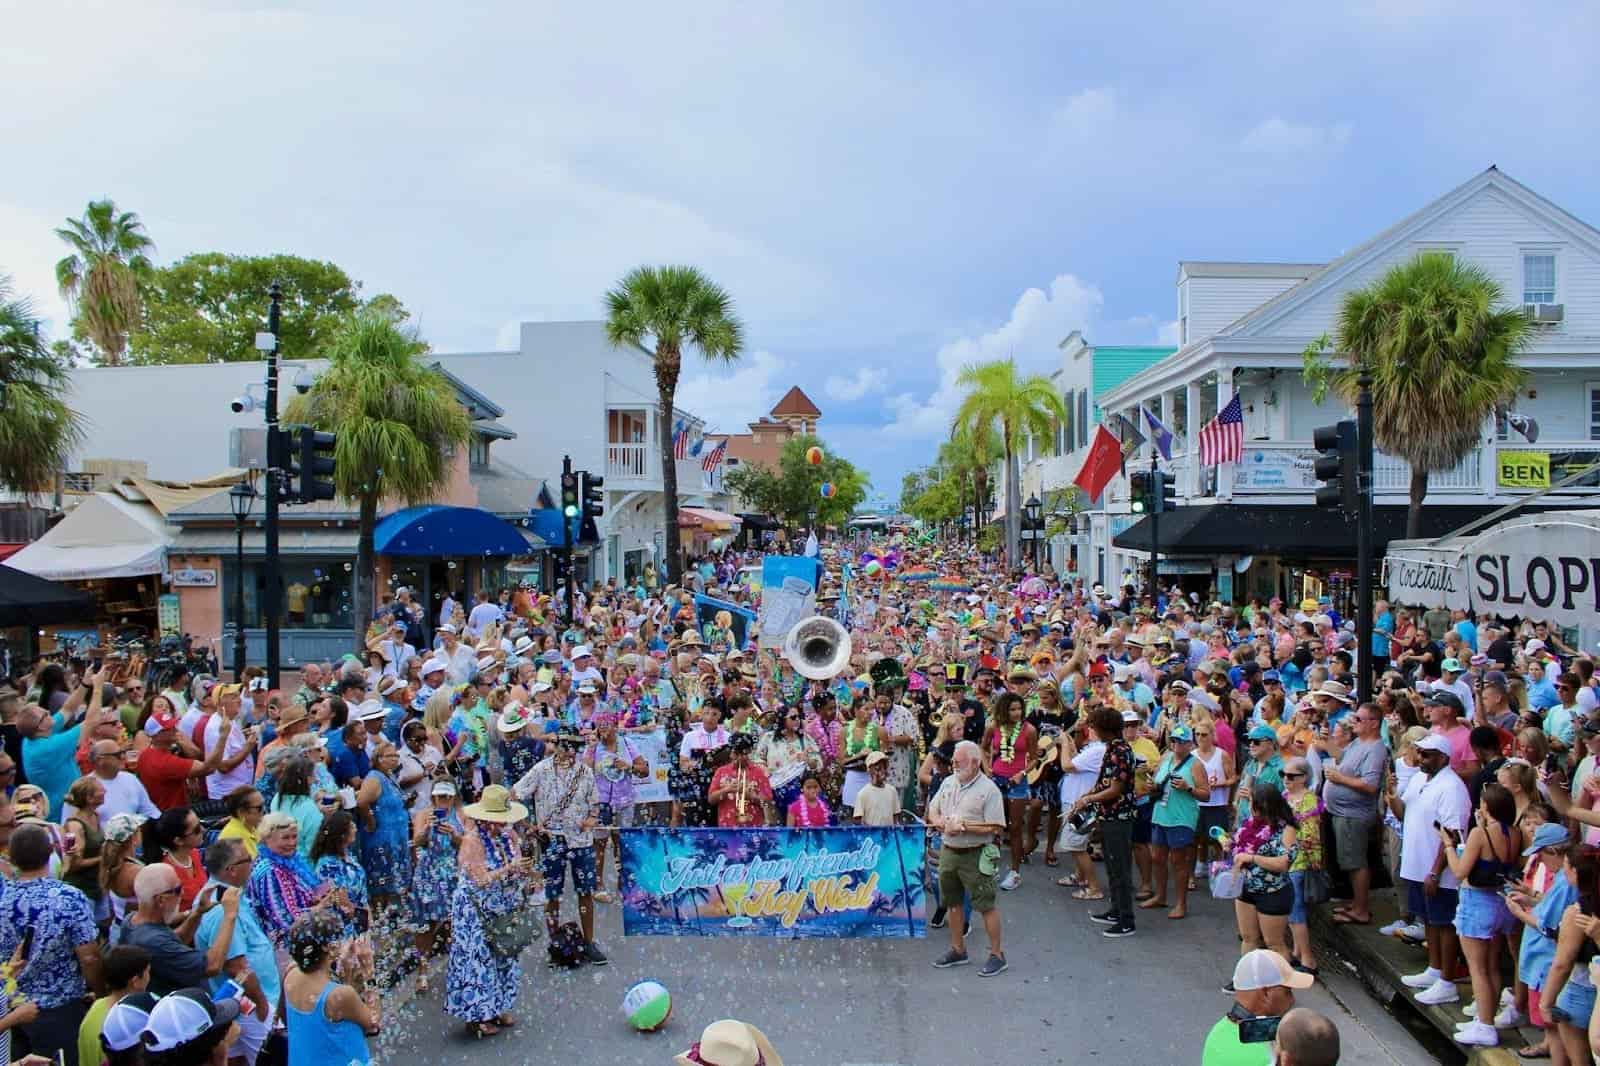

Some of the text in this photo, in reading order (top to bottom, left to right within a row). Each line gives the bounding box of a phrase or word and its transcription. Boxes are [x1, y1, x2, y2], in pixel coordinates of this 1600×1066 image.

[1502, 465, 1545, 480] BEN
[1400, 558, 1456, 593] Cocktails
[662, 837, 880, 893] Just a few friends
[743, 872, 879, 928] Key West
